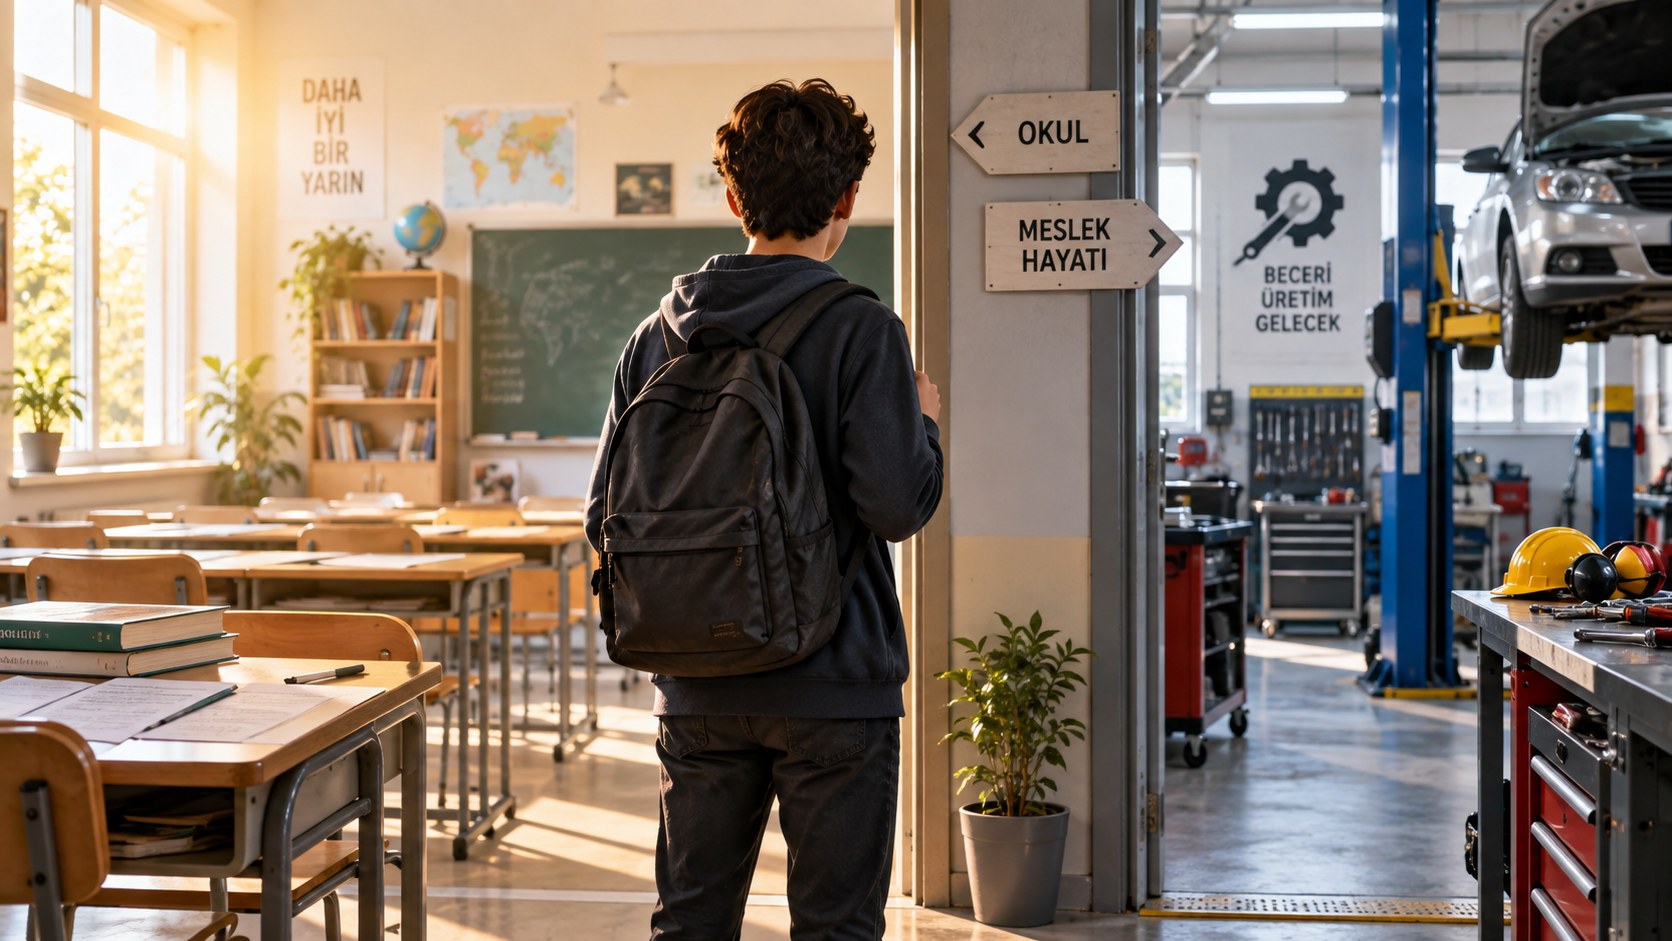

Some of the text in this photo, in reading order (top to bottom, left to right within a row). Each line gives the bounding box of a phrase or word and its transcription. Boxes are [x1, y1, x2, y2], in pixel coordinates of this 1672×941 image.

[302, 77, 363, 103] DAHA
[316, 104, 345, 135] İYİ
[1018, 119, 1089, 145] OKUL
[313, 137, 350, 165] BİR
[301, 170, 364, 195] YARIN
[1019, 217, 1111, 242] MESLEK
[1022, 248, 1107, 273] HAYATI
[1264, 260, 1332, 284] BECERİ
[1261, 286, 1333, 309] ÜRETİM
[1255, 313, 1341, 333] GELECEK
